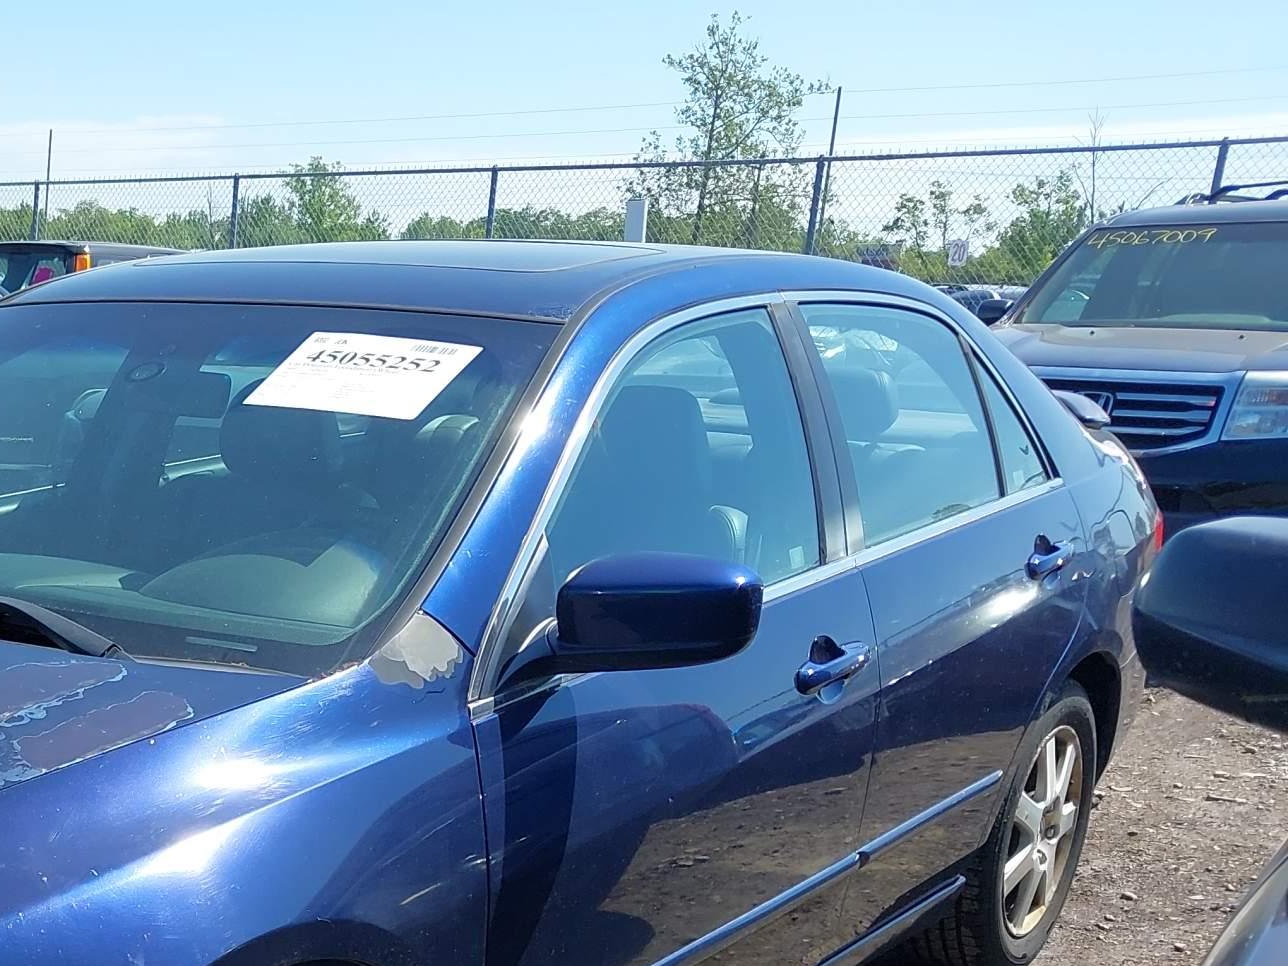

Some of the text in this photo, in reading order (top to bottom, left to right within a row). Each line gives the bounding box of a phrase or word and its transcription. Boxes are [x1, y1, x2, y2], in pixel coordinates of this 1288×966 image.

[1087, 227, 1218, 249] 45067009
[951, 243, 966, 262] 20
[305, 348, 442, 374] 45055252
